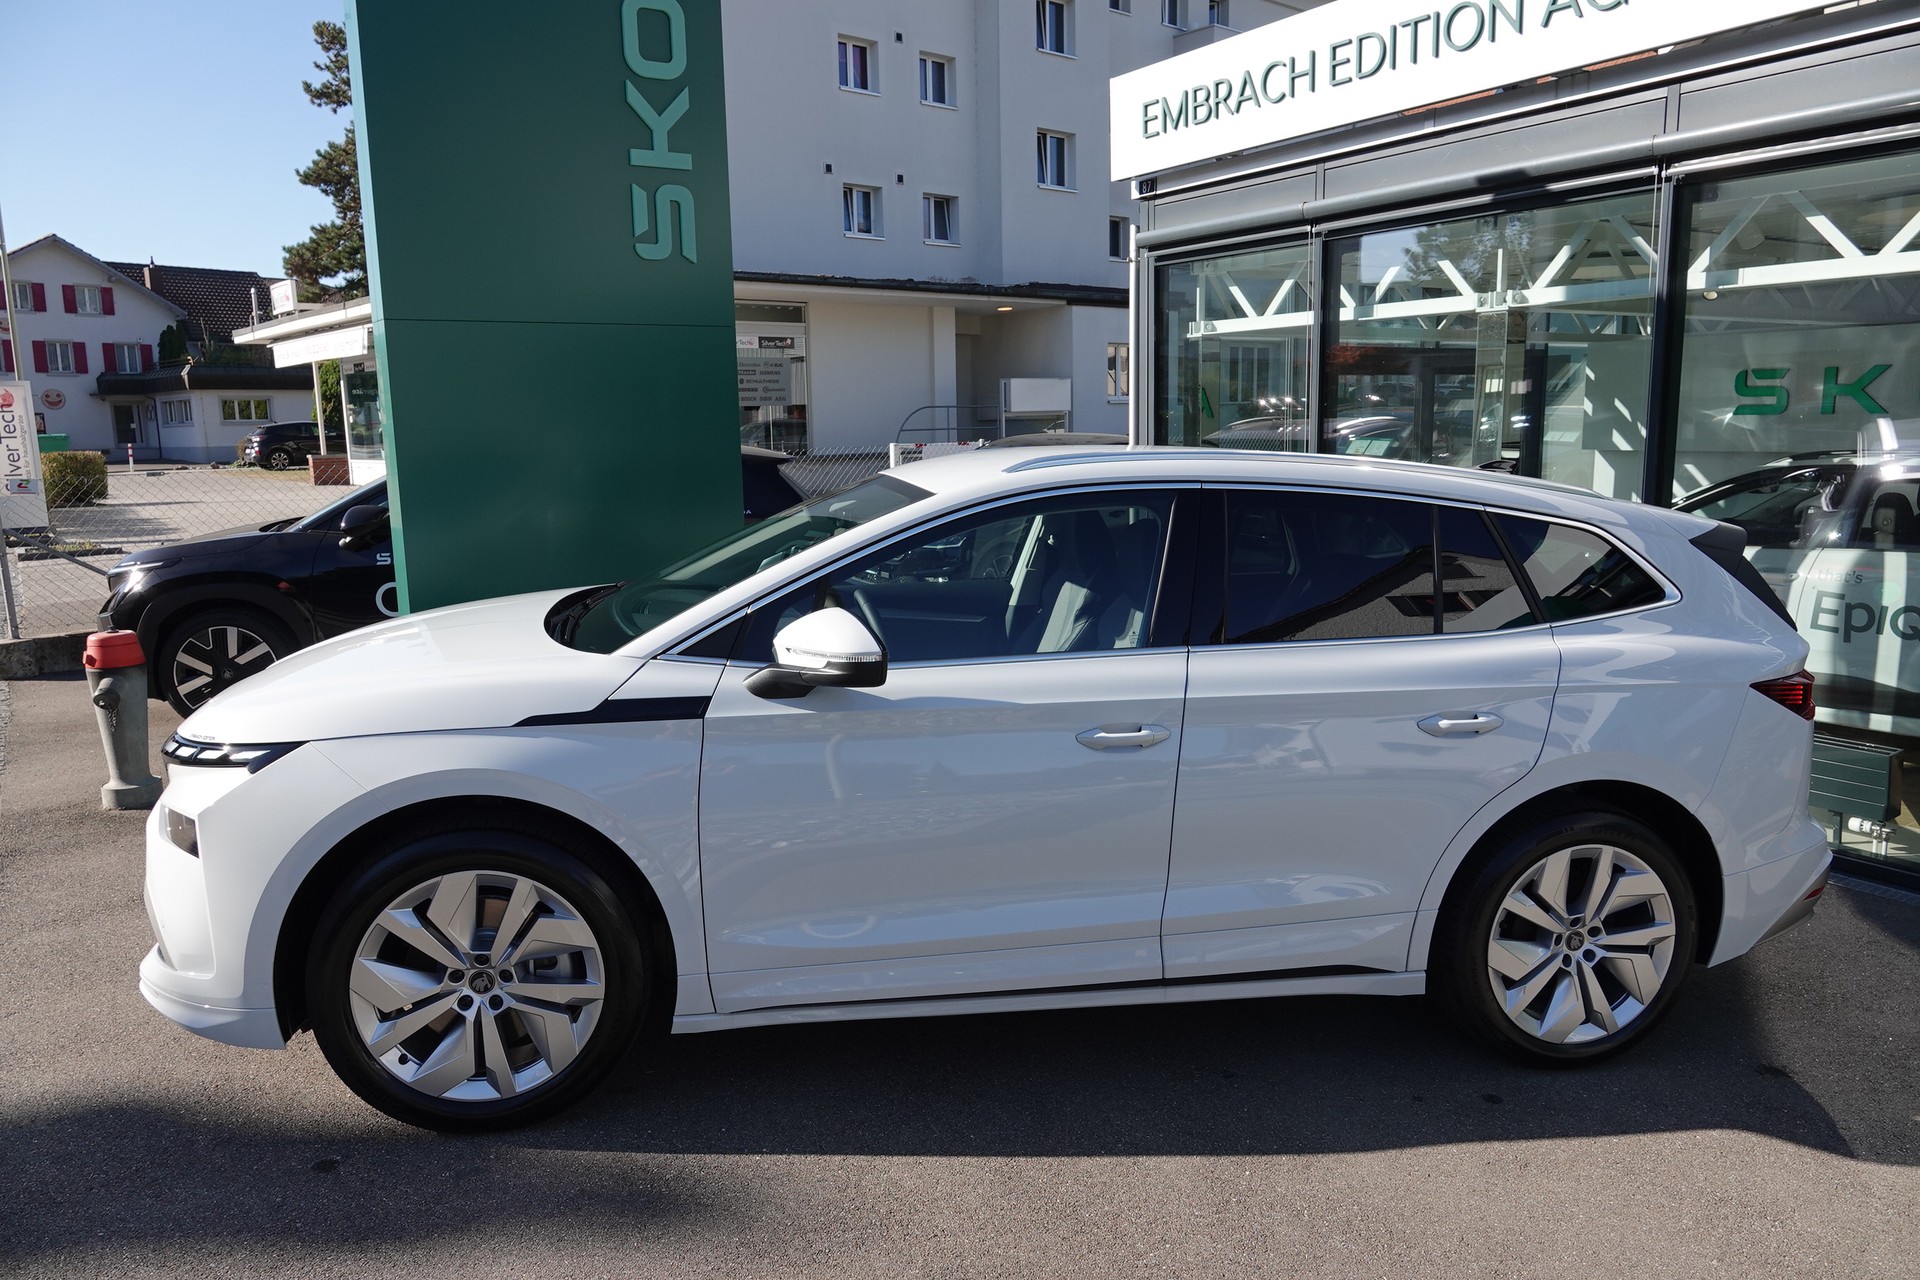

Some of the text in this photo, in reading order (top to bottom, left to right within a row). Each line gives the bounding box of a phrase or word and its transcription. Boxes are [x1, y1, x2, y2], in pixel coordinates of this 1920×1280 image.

[1142, 50, 1316, 139] EMBRACH
[1329, 0, 1524, 87] EDITION
[1142, 181, 1152, 194] 87
[1817, 569, 1864, 584] that's
